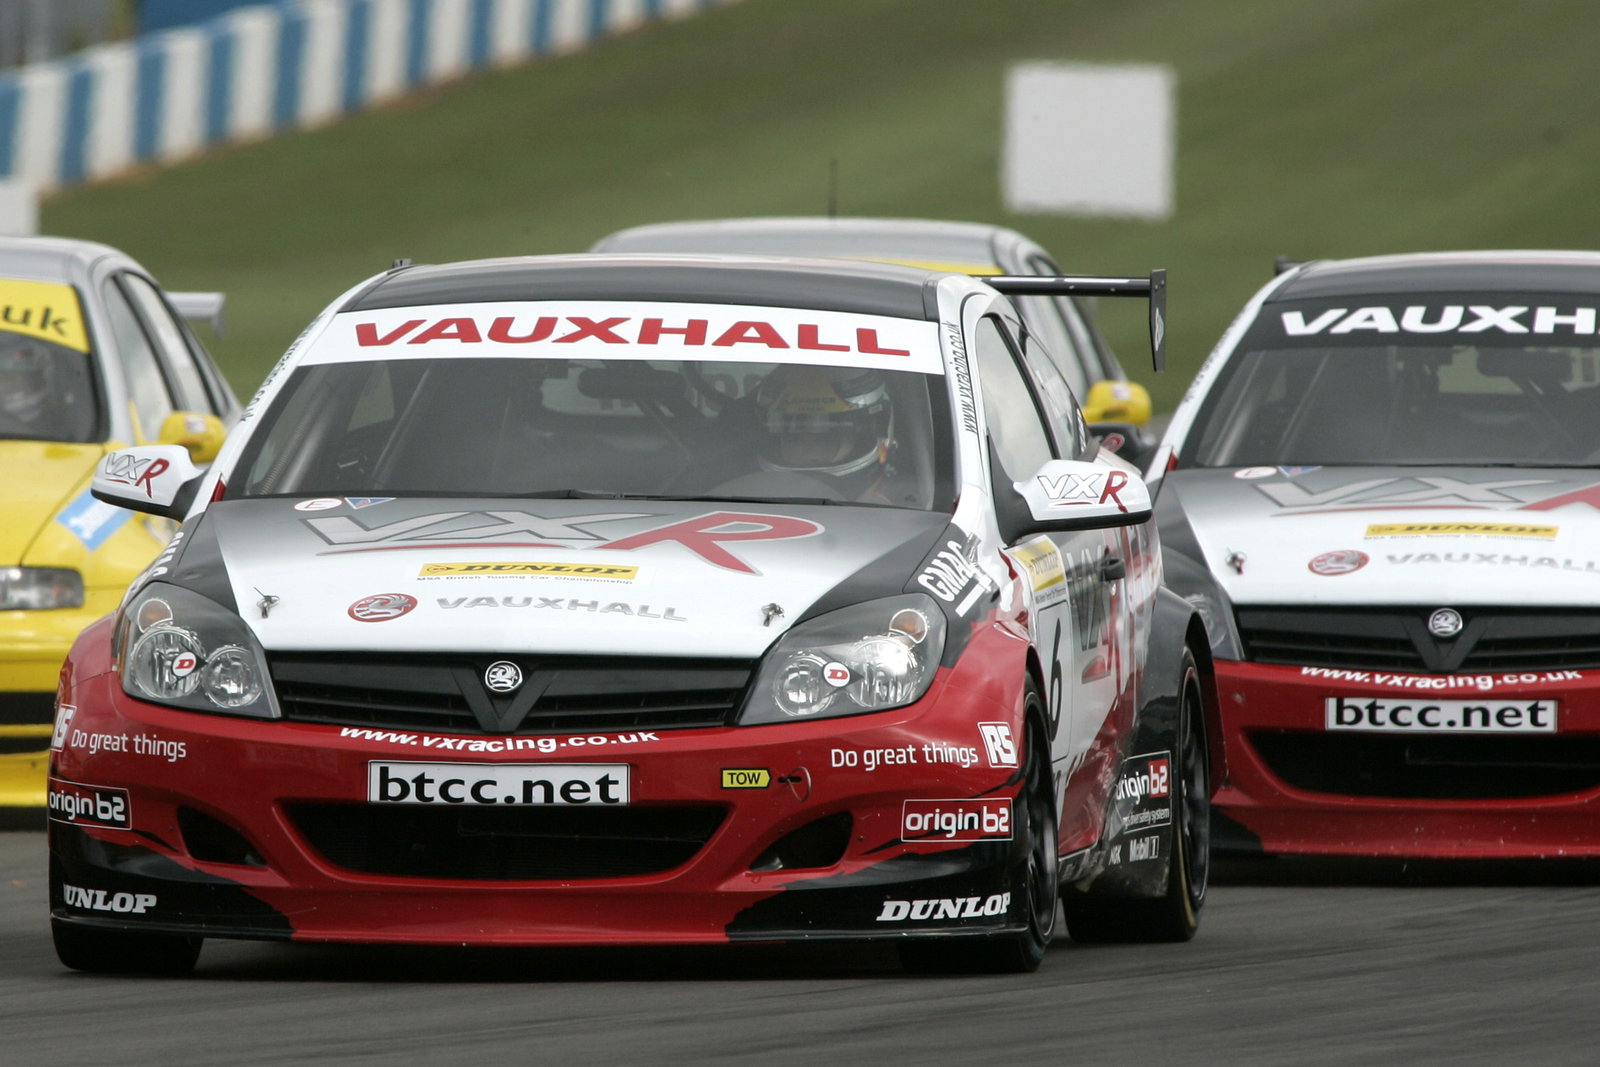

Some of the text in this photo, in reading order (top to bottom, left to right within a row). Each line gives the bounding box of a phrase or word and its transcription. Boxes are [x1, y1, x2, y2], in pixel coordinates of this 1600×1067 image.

[1282, 305, 1600, 335] VAUXH
[355, 316, 911, 356] VAUXHALL
[942, 320, 978, 435] www.vxracing.co.uk
[105, 452, 170, 499] VXR
[1037, 471, 1129, 513] VXR
[298, 511, 825, 576] VXR
[1404, 525, 1552, 533] DUNLOP
[458, 565, 633, 574] DUNLOP
[918, 541, 976, 602] GMAC
[1386, 553, 1600, 573] VAUXHALL
[436, 595, 688, 621] VAUXHALL
[1050, 618, 1062, 742] 6
[1301, 666, 1583, 691] www.vxracing.co.uk
[1335, 698, 1548, 728] btcc.net
[71, 729, 187, 763] Do great things
[340, 727, 660, 753] www.vxracing.co.uk
[831, 742, 979, 772] Do great things
[379, 766, 620, 804] btcc.net
[727, 772, 761, 785] TOW
[63, 884, 157, 914] UNLOP
[876, 891, 1011, 921] DUNLOP
